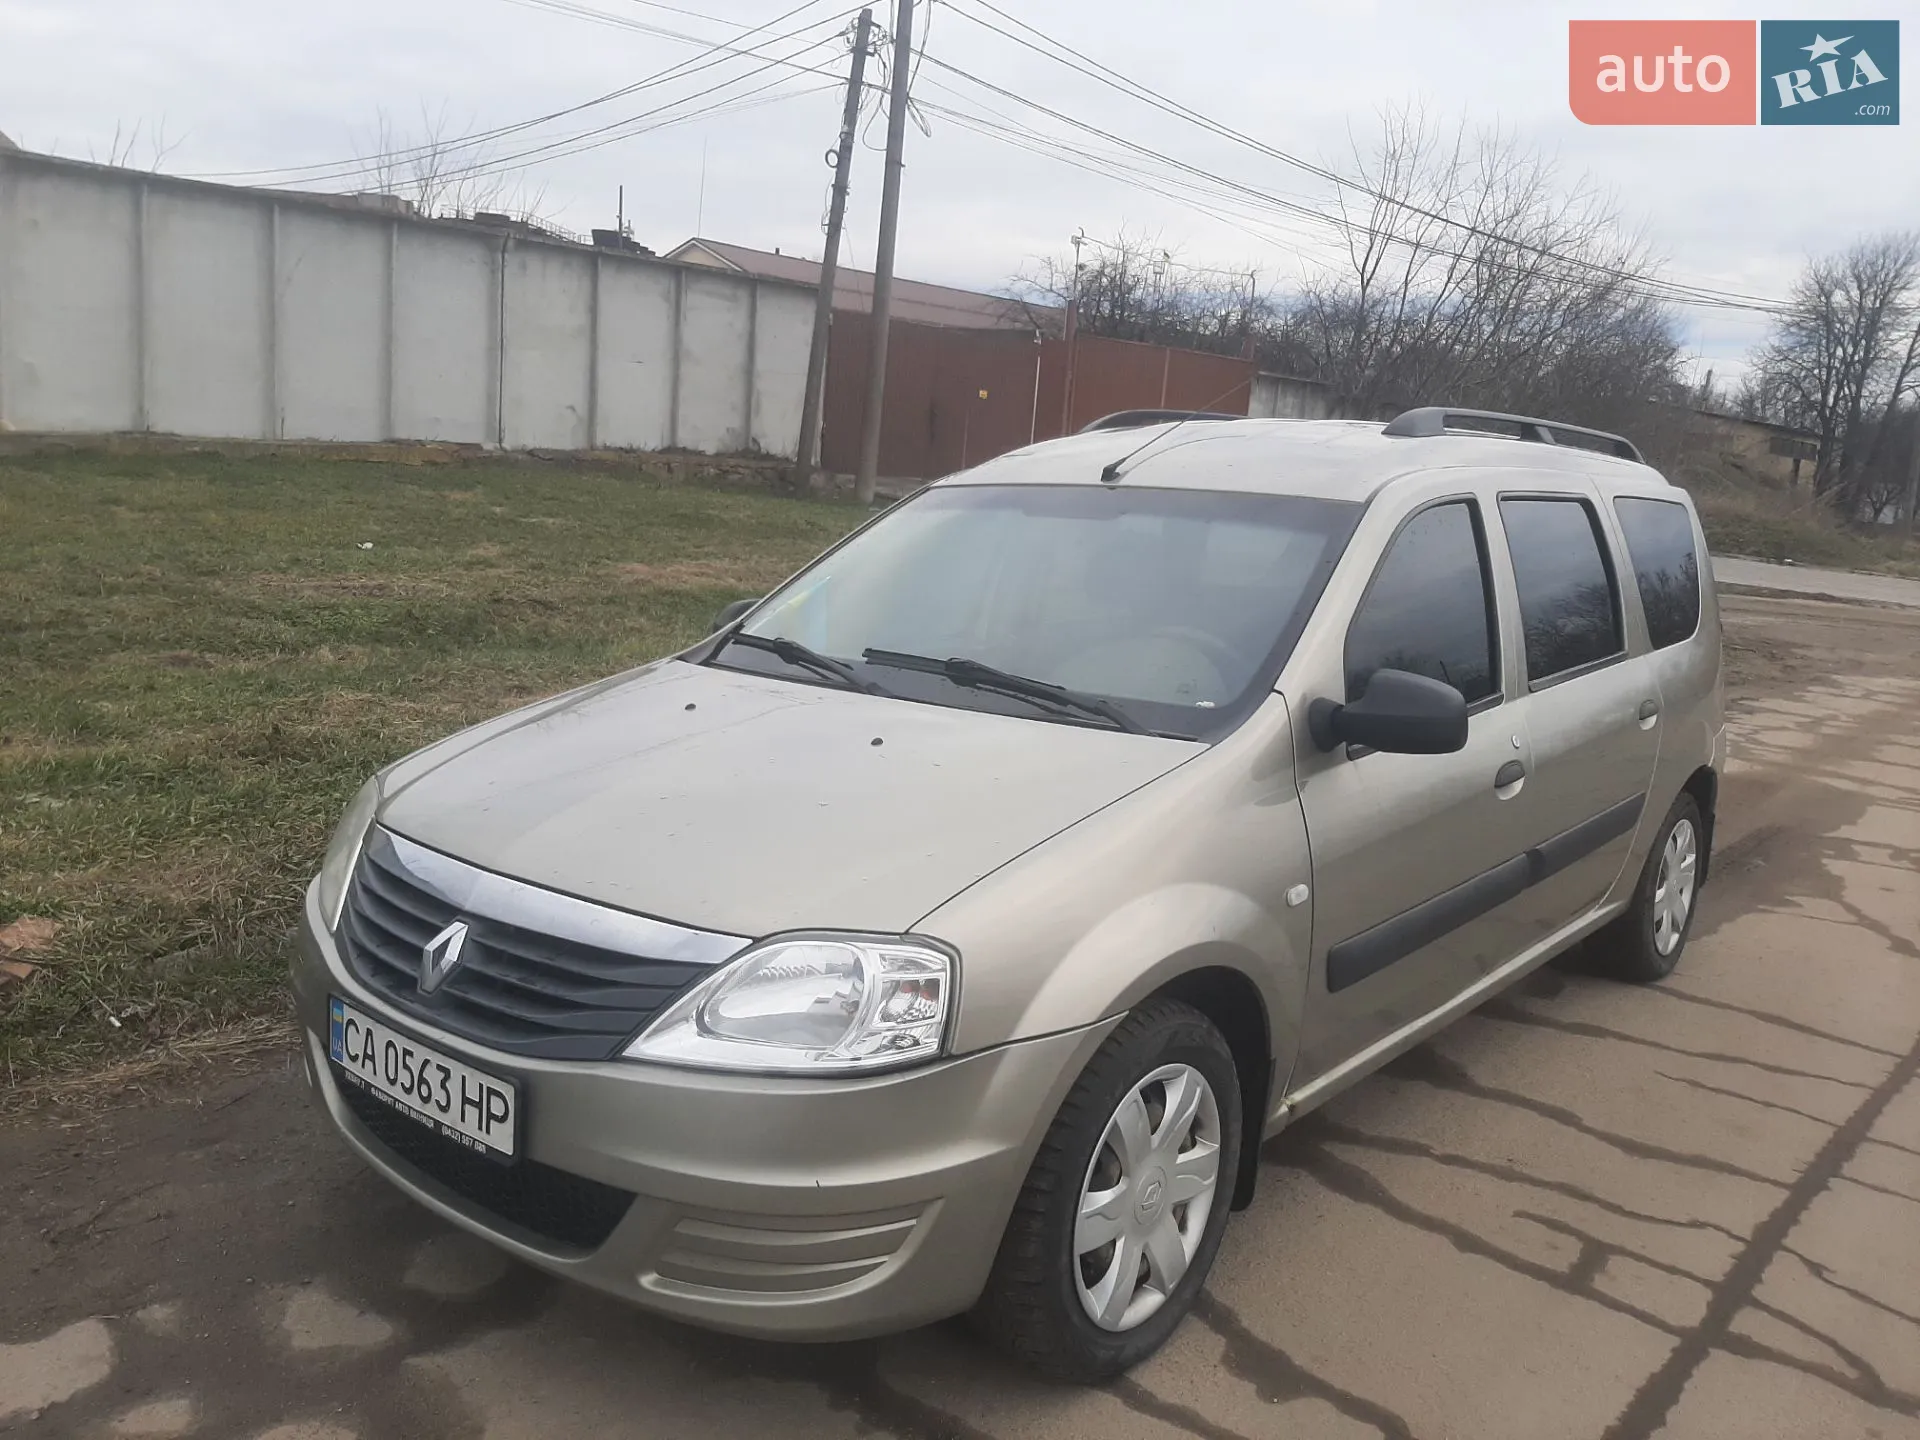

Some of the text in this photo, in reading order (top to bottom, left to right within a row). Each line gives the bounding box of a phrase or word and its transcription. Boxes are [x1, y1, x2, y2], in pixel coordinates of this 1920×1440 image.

[333, 1037, 343, 1055] UA
[344, 1018, 510, 1135] CA 0563 HP
